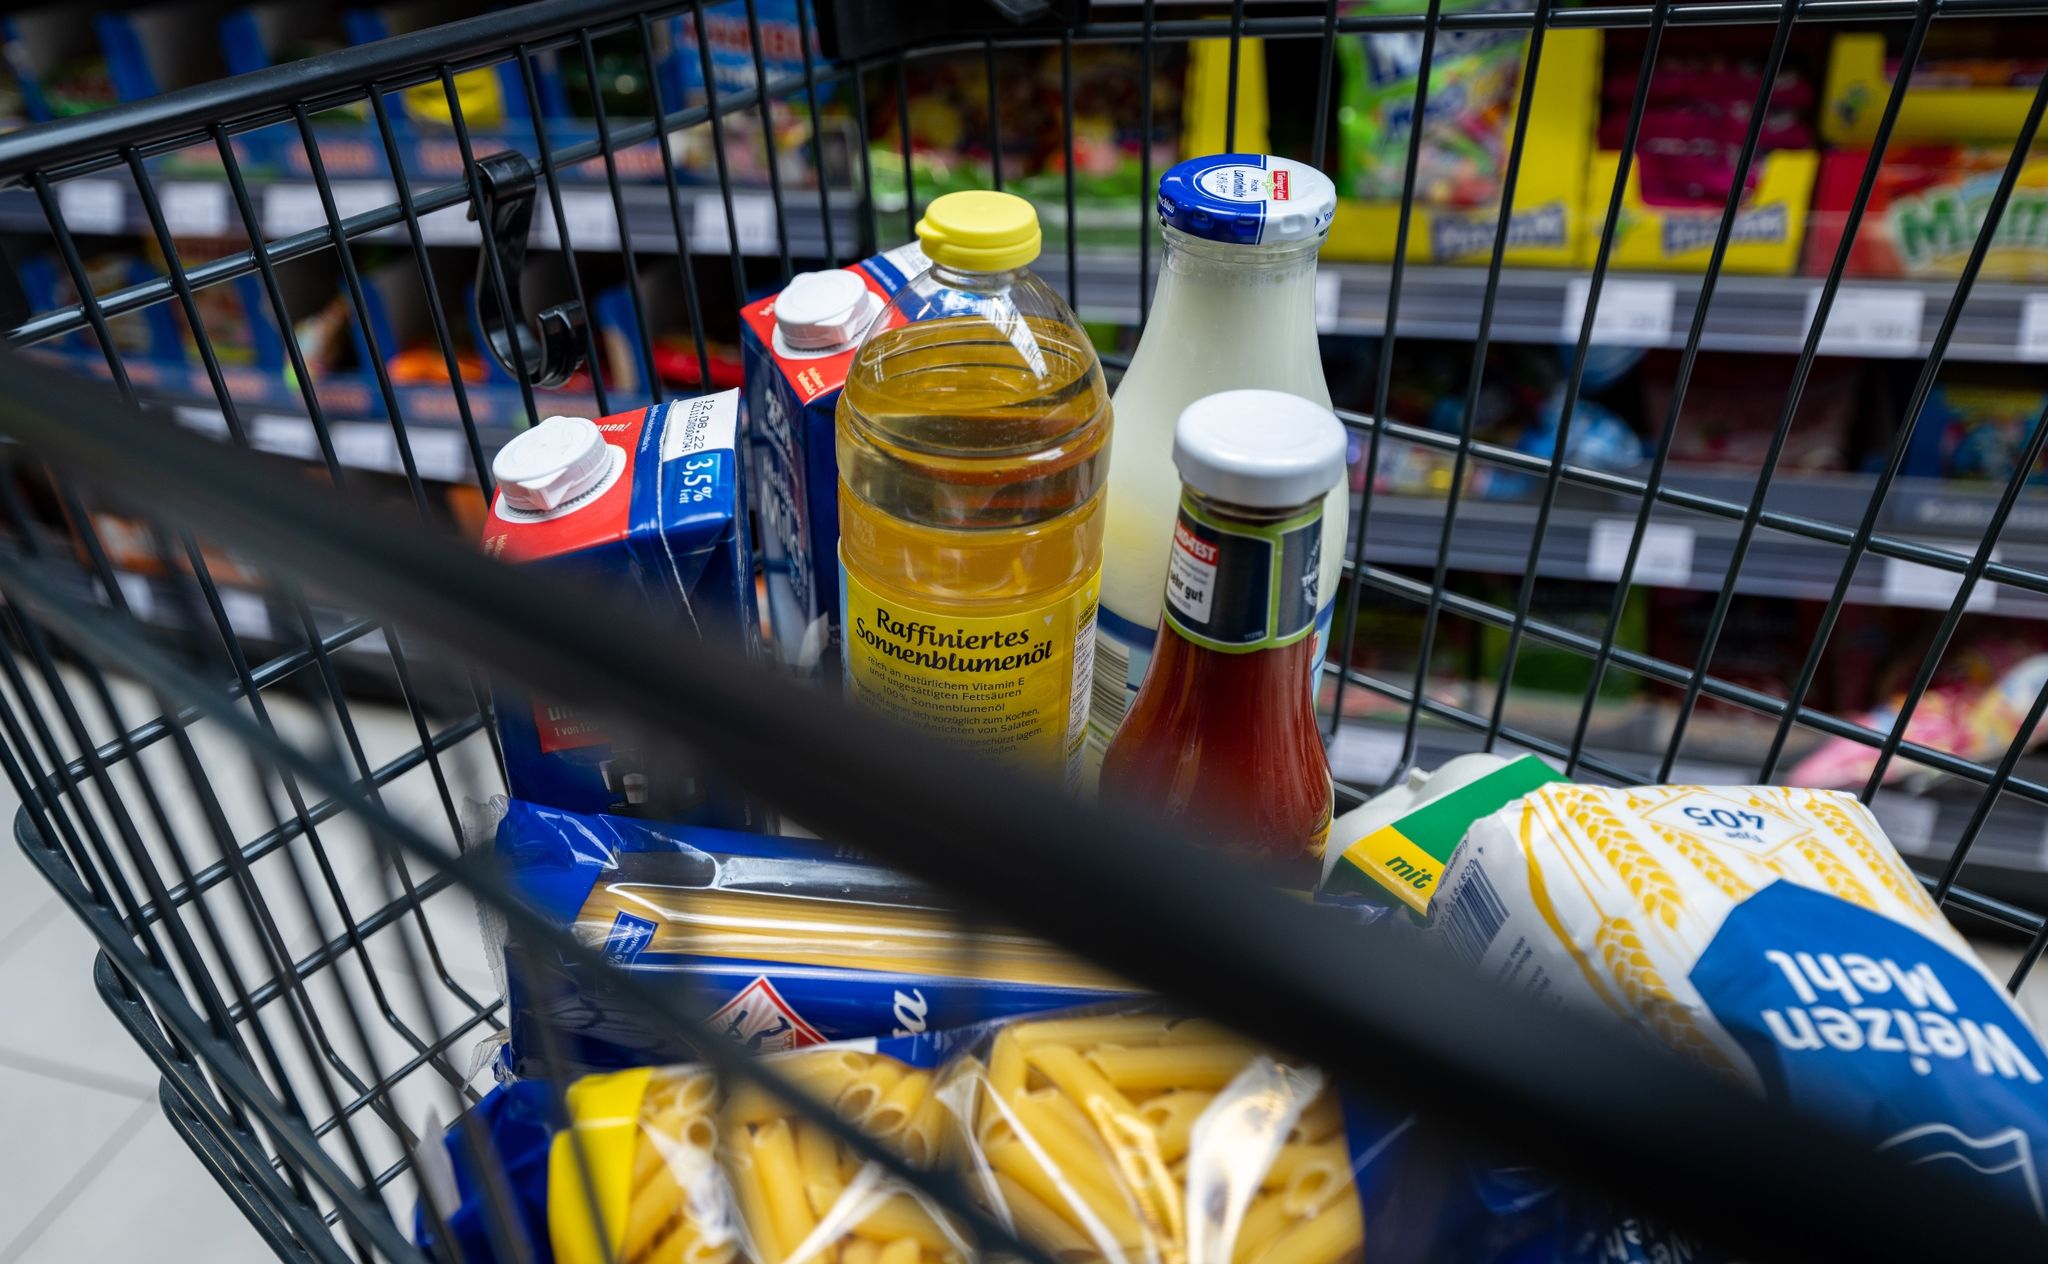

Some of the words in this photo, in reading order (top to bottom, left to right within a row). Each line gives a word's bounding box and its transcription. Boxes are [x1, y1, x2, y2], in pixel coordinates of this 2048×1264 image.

[693, 399, 715, 450] 12.08.22
[1185, 585, 1204, 604] gut
[856, 617, 1053, 673] Sonnenblumenöl
[876, 608, 1029, 650] Raffiniertes
[869, 667, 886, 682] und
[888, 675, 959, 701] ungesättigten
[962, 688, 1022, 702] Fettsäuren
[890, 668, 901, 678] an
[904, 674, 969, 691] natürlichem
[973, 680, 1014, 691] Vitamin
[1018, 677, 1025, 687] E
[882, 685, 908, 703] 100%
[911, 697, 1005, 713] Sonnenblumenöl
[913, 707, 931, 721] sich
[932, 713, 981, 728] vorzüglich
[983, 716, 1003, 726] zum
[978, 725, 997, 735] von
[1000, 718, 1040, 733] Salaten.
[1682, 807, 1765, 831] 405
[1385, 855, 1433, 890] mit
[1764, 949, 1957, 1014] Mehl
[1761, 1006, 2044, 1084] Weizen
